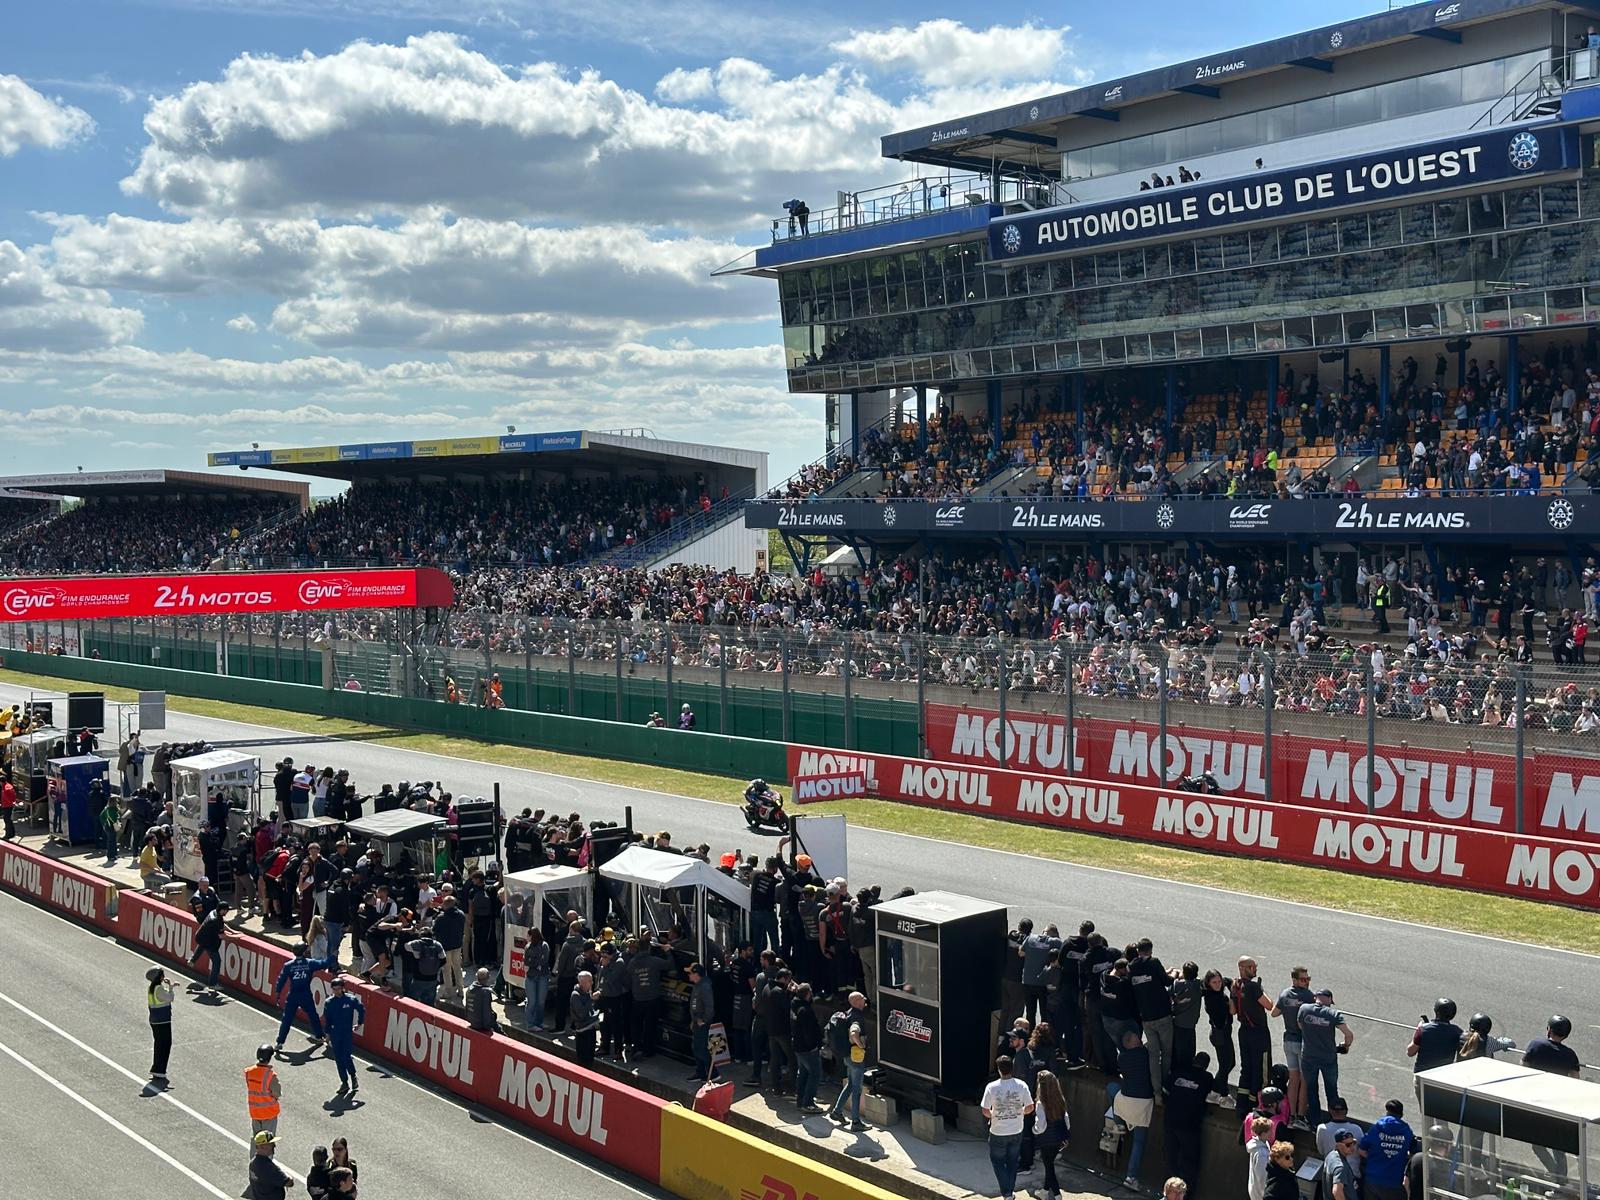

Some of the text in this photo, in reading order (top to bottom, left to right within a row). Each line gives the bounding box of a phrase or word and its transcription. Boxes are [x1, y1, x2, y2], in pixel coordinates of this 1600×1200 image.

[1435, 3, 1460, 16] WEC
[1211, 67, 1221, 75] LE
[1222, 61, 1245, 72] MANS
[1038, 146, 1481, 245] AUTOMOBILE CLUB DE L'OUEST
[778, 507, 844, 526] 24h LE MANS
[936, 506, 965, 518] WEC
[1012, 506, 1101, 527] 24h LE MANS
[1230, 504, 1272, 518] WEC
[1335, 503, 1465, 528] 24h LE MANS
[12, 594, 55, 608] EWC
[79, 594, 130, 602] ENDURANCE
[154, 585, 272, 608] 24h MOTOS
[306, 586, 342, 598] EWC
[951, 713, 1084, 772] MOTUL
[1109, 729, 1266, 795] MOTUL
[799, 776, 865, 799] MOTUL
[900, 764, 992, 806] MOTUL
[1017, 779, 1124, 827] MOTUL
[1301, 749, 1503, 825] MOTUL
[1152, 797, 1279, 849] MOTUL
[1313, 818, 1464, 877] MOTUL
[3, 853, 42, 896] MOTUL
[51, 872, 96, 919] MOTUL
[139, 908, 195, 961] MOTUL
[384, 1007, 474, 1085] MOTUL
[498, 1055, 608, 1145] MOTUL
